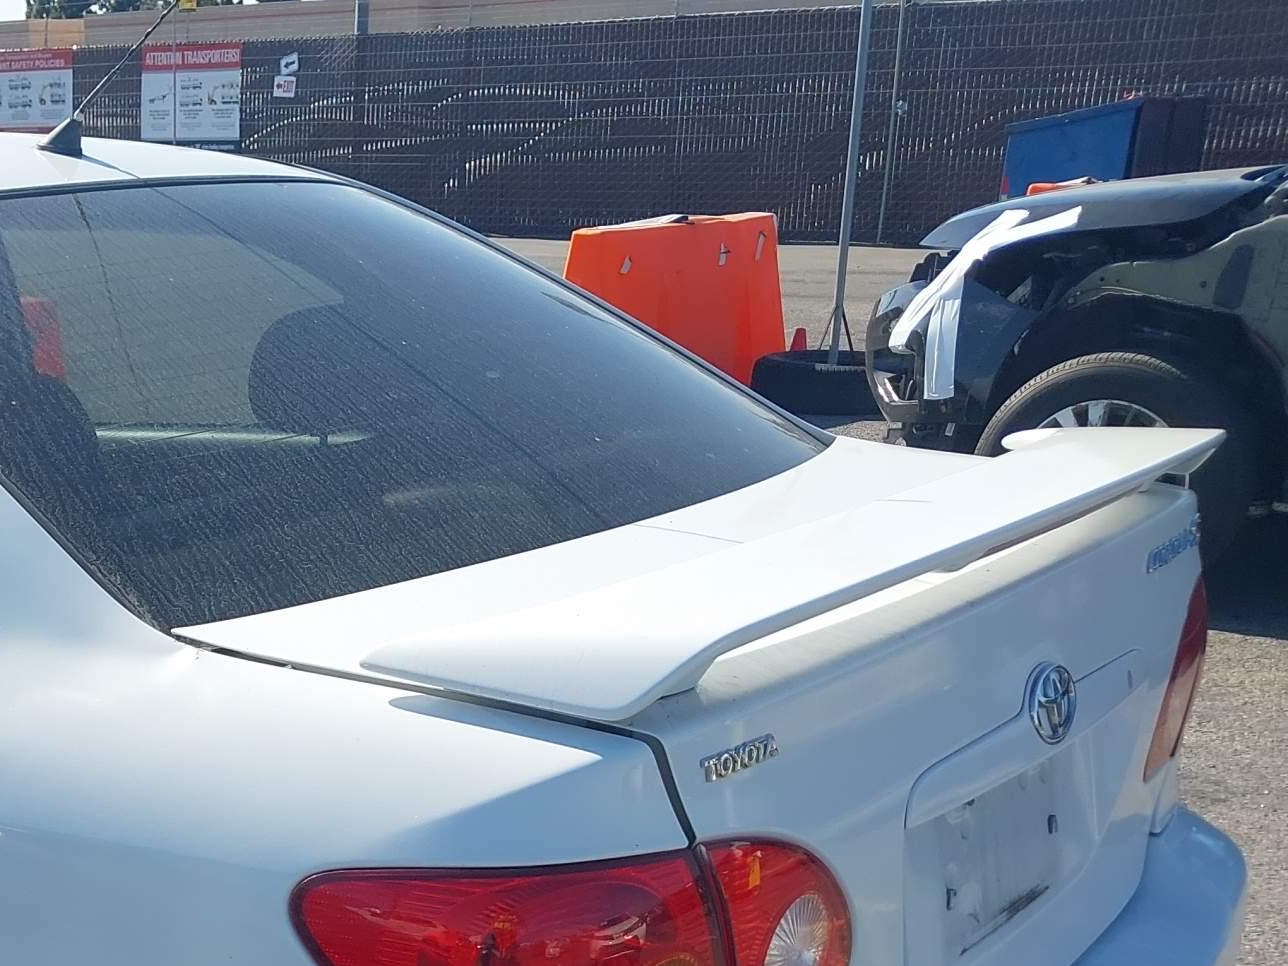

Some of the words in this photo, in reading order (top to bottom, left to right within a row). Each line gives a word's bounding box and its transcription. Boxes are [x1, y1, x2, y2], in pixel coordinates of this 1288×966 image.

[145, 51, 182, 65] ATTENTION
[184, 49, 240, 64] TRANSPORTERS!
[700, 733, 778, 783] TOYOTA
